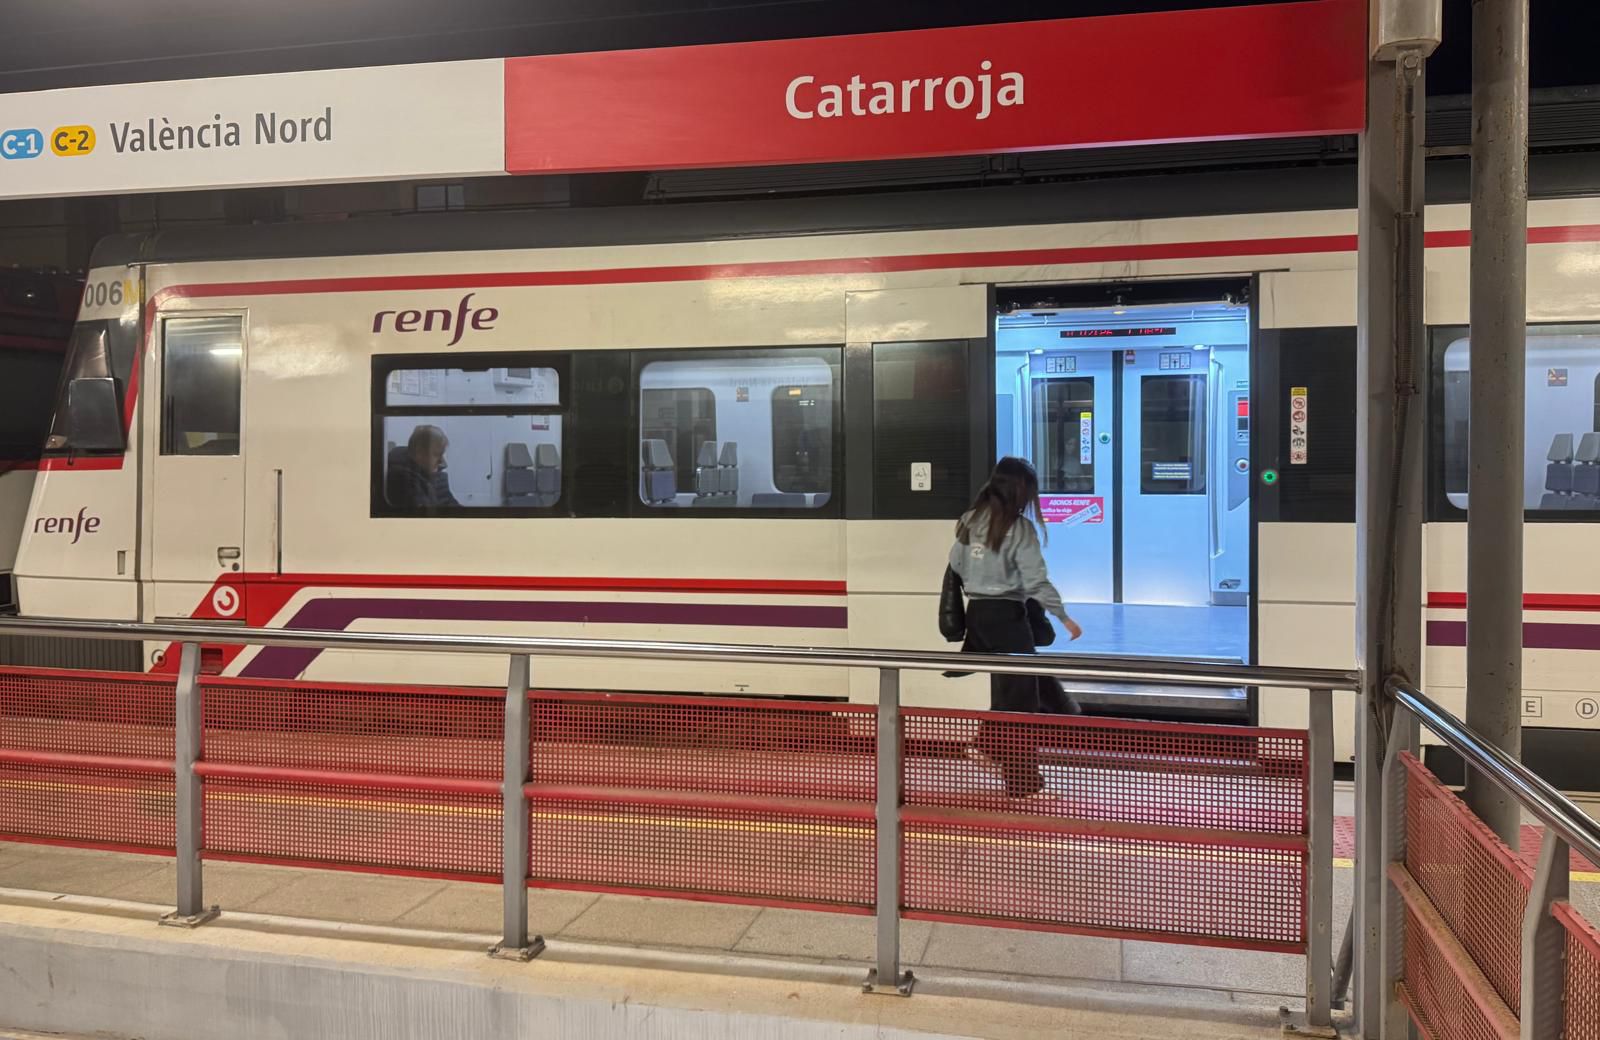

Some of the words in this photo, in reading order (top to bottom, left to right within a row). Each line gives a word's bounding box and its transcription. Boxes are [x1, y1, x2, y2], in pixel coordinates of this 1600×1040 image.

[785, 60, 1024, 120] Catarroja
[1, 132, 38, 155] C-1
[54, 130, 90, 152] C-2
[110, 113, 241, 154] València
[255, 106, 332, 145] Nord
[372, 292, 499, 347] renfe
[33, 506, 101, 545] renfe
[1525, 700, 1536, 713] E
[1582, 702, 1594, 715] D
